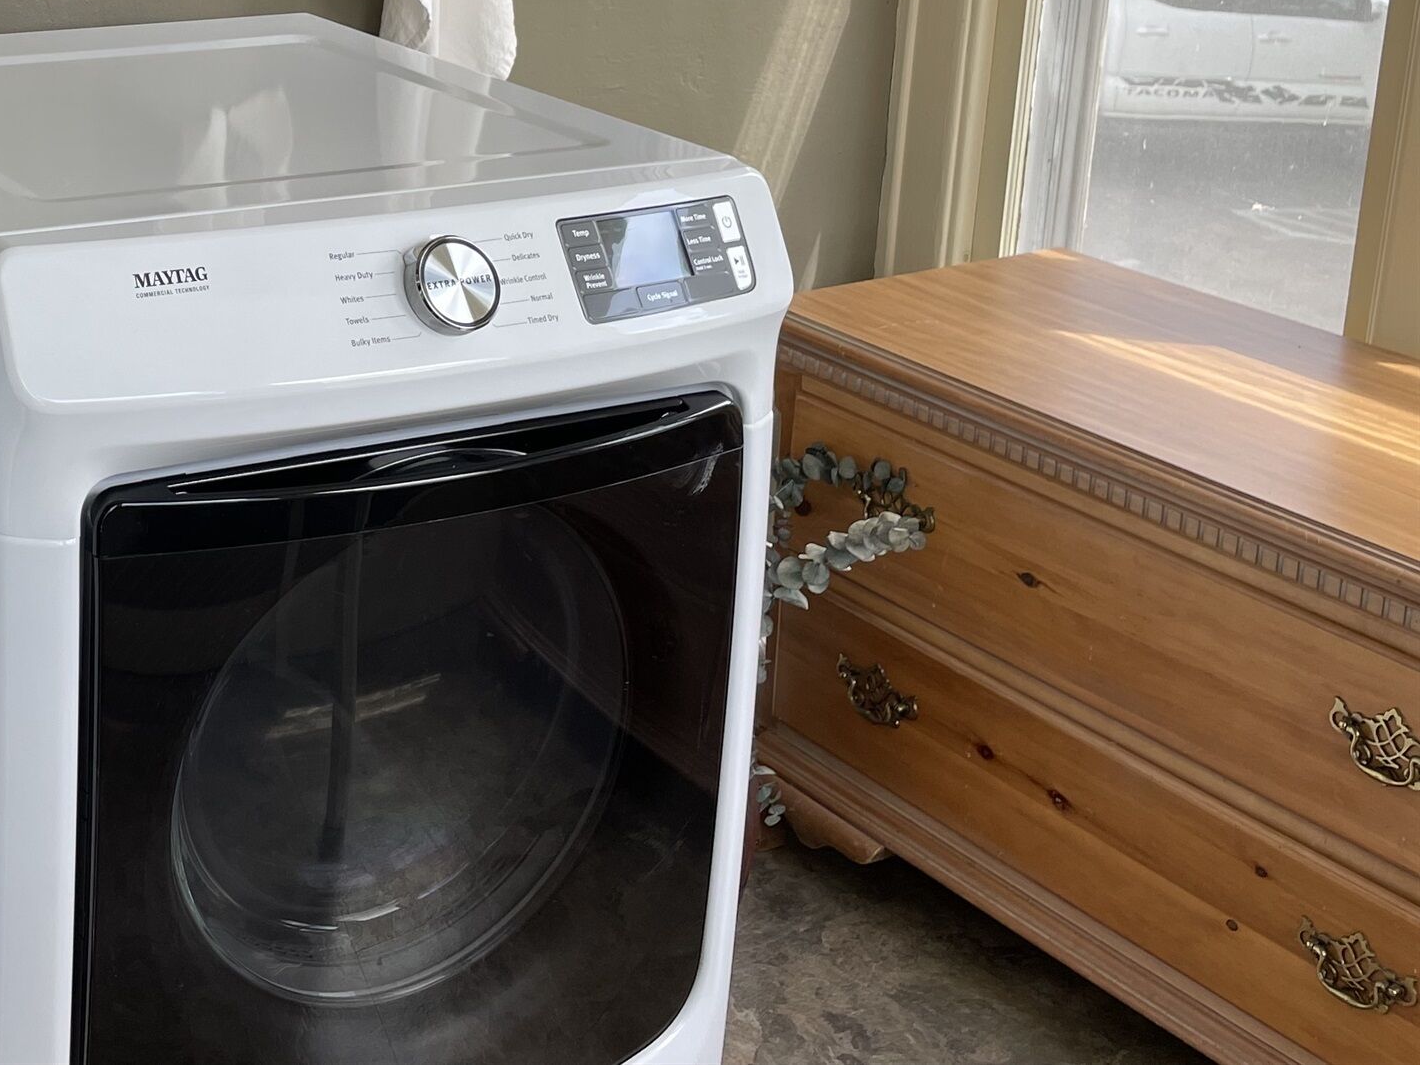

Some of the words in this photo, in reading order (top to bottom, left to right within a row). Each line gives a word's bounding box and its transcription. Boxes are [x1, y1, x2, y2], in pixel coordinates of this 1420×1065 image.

[504, 233, 521, 242] Quick
[522, 231, 534, 240] Dry
[572, 229, 590, 238] Temp
[329, 251, 355, 261] Regular
[512, 252, 540, 261] Delicates
[576, 252, 601, 262] Dryness
[132, 267, 208, 289] MAYTAG
[335, 273, 355, 282] Heavy
[356, 271, 373, 281] Duty
[500, 275, 523, 285] Wrinkle
[525, 272, 547, 282] Control
[583, 273, 605, 282] Wrinkle
[427, 279, 457, 291] EXTRA
[460, 274, 492, 285] POWER
[586, 280, 607, 289] Prevent
[136, 289, 173, 299] COMMERCIAL
[175, 285, 210, 294] TECHNOLOGY
[646, 292, 661, 302] Cycle
[340, 295, 364, 304] Whites
[531, 293, 553, 302] Normal
[346, 316, 369, 325] Towels
[528, 316, 546, 325] Timed
[547, 313, 559, 323] Dry
[351, 338, 371, 348] Bulky
[372, 335, 391, 344] Items
